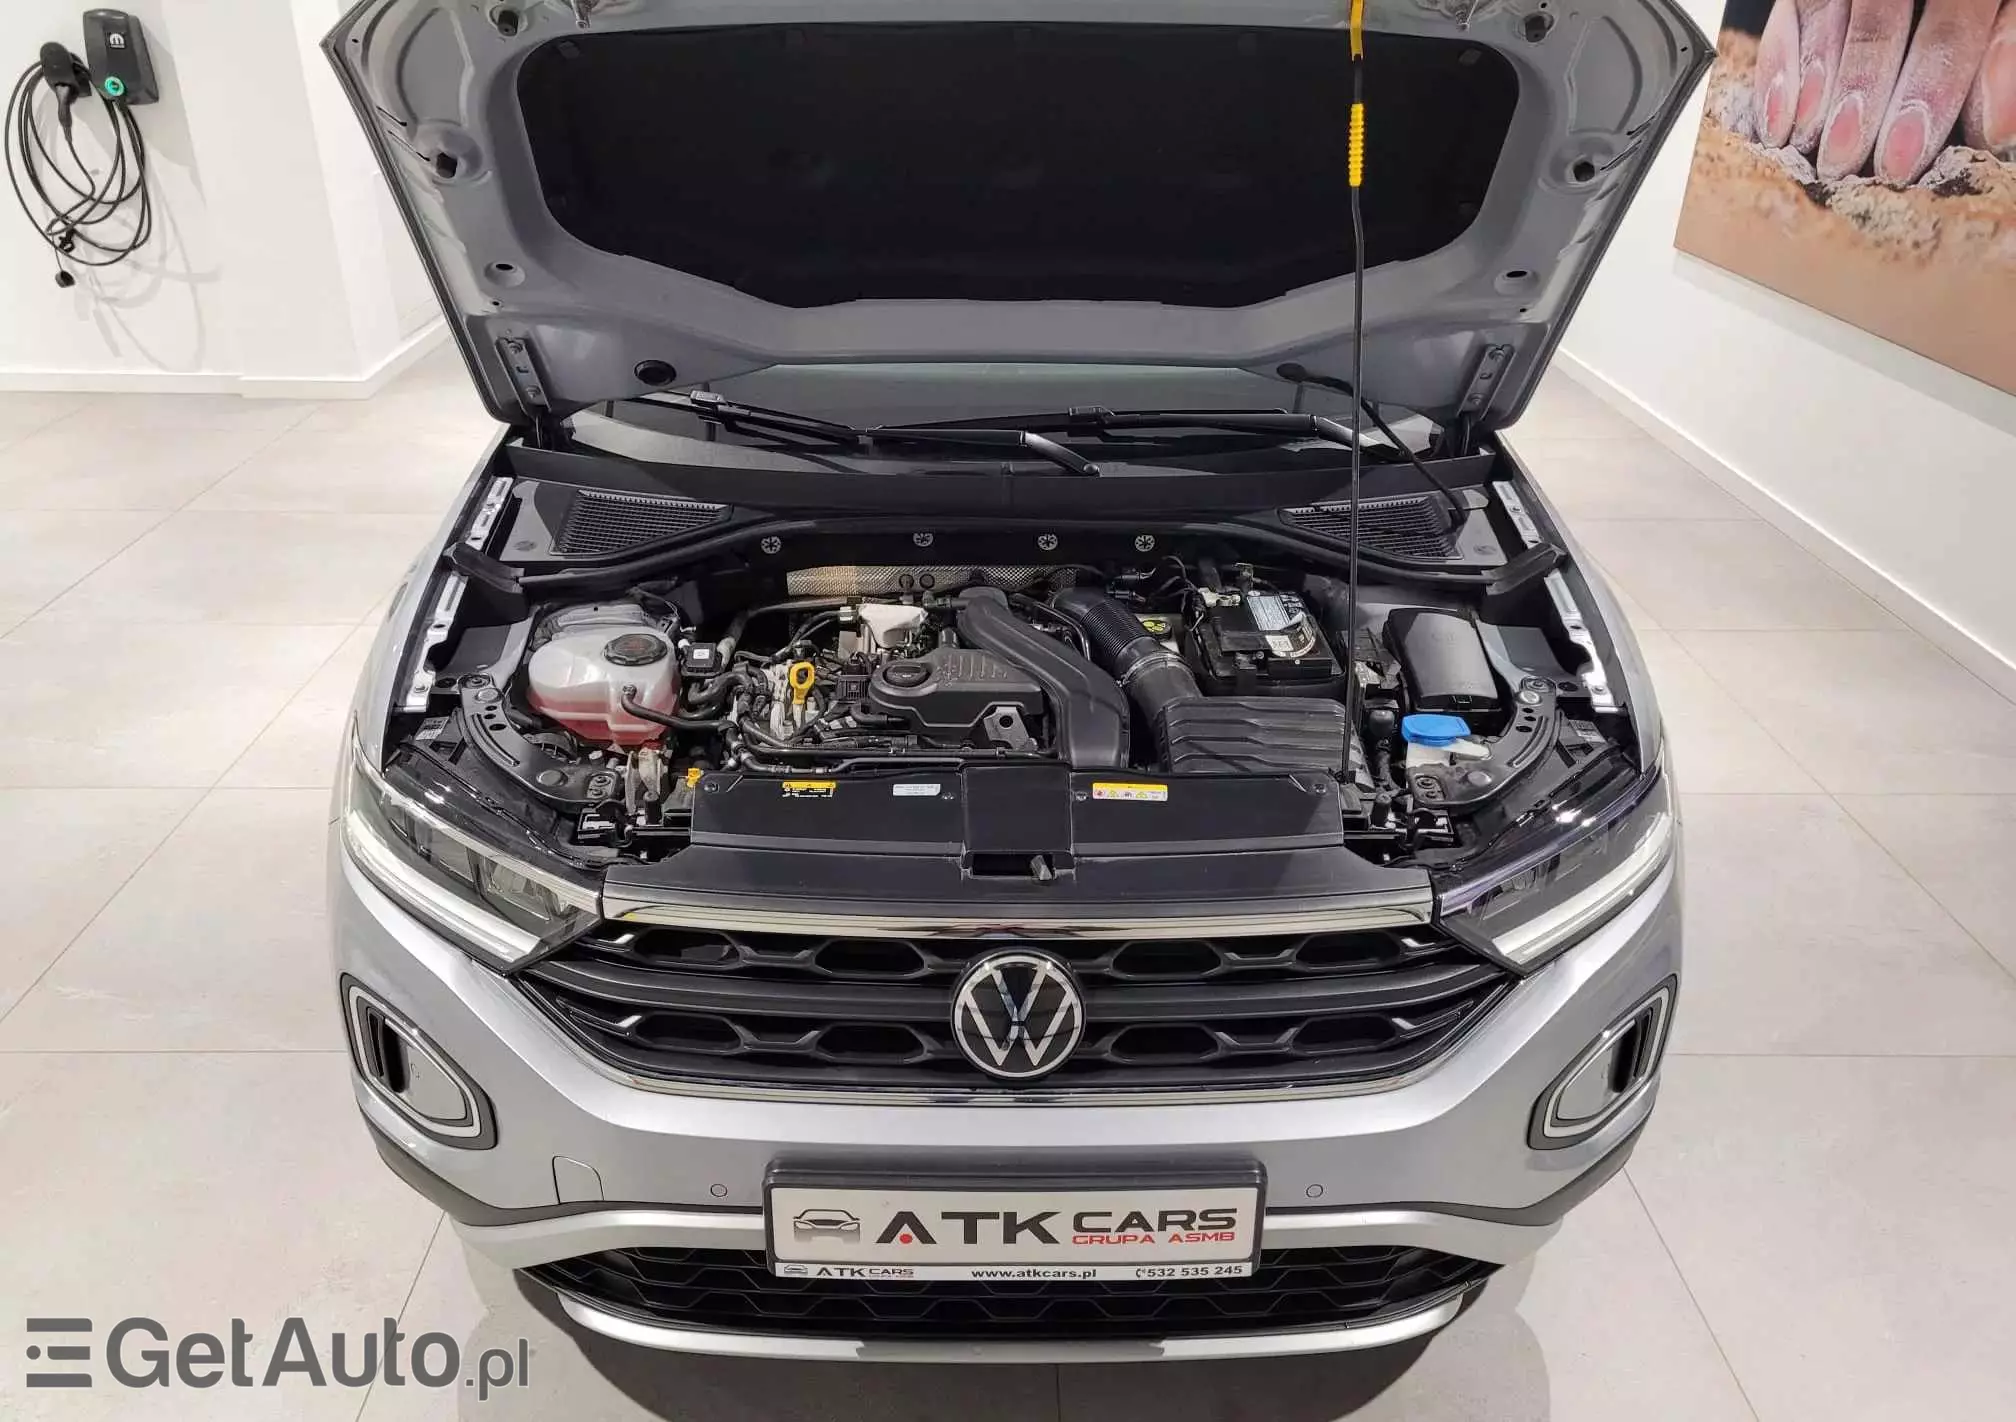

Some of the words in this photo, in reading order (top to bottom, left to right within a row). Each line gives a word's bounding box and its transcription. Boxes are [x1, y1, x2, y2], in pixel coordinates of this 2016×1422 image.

[1073, 1208, 1238, 1232] CARS
[876, 1211, 1062, 1244] ATK
[1072, 1232, 1155, 1244] GRUPA
[1168, 1231, 1235, 1243] ASMB
[817, 1267, 866, 1277] ATK
[971, 1268, 1097, 1279] www.atkcars.pl
[1147, 1267, 1176, 1277] 532
[1181, 1266, 1209, 1276] 535
[1214, 1265, 1243, 1275] 245
